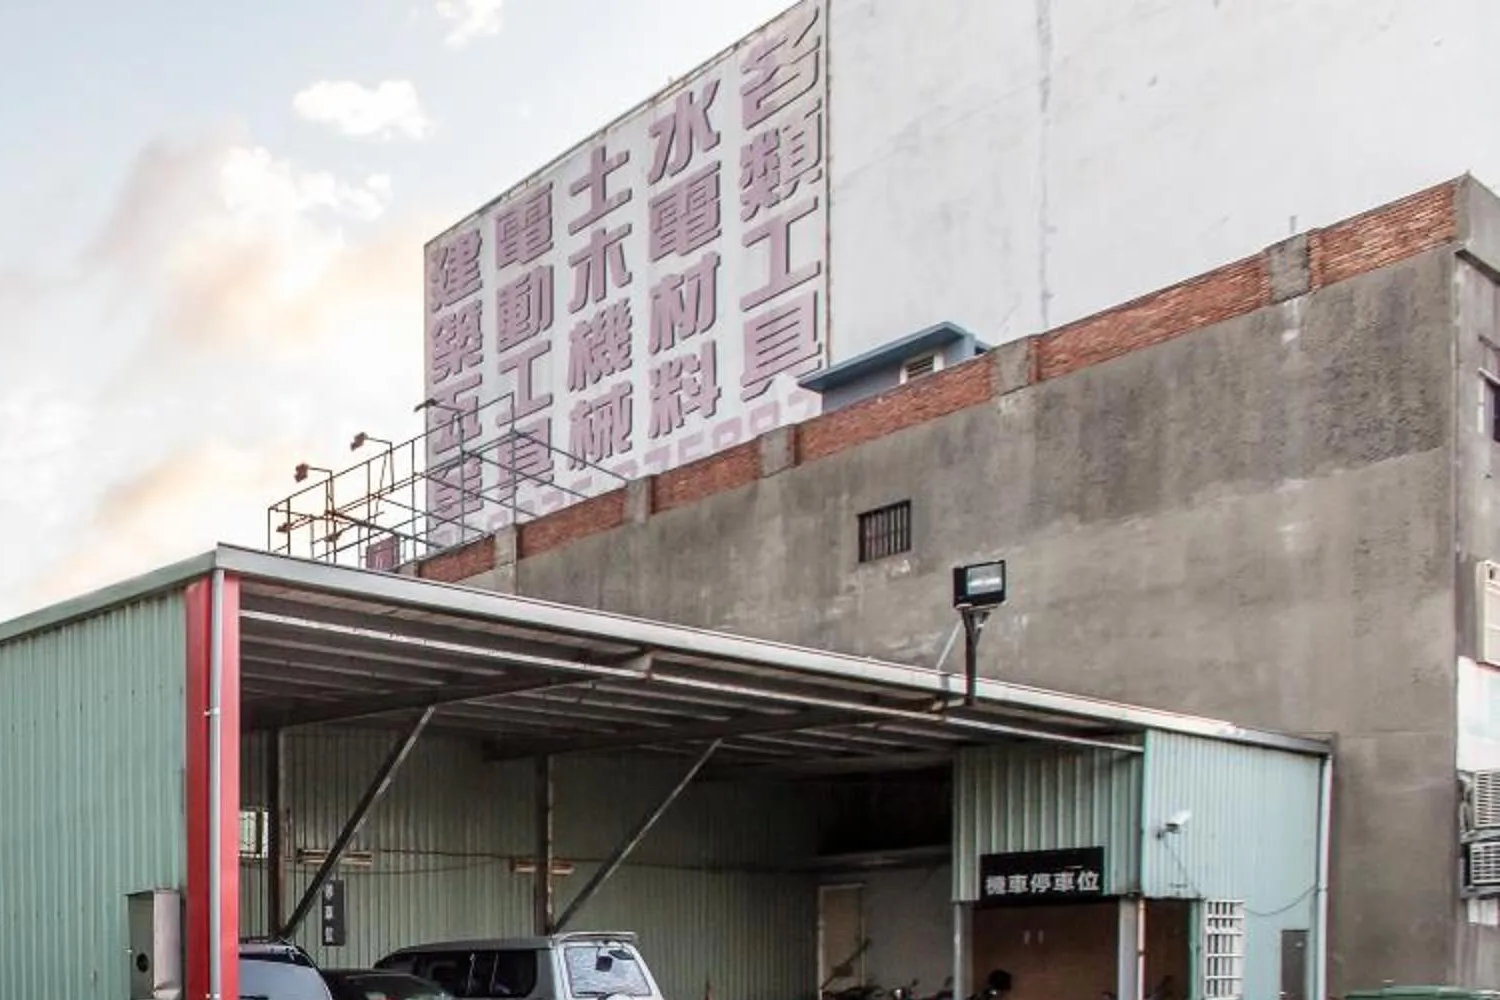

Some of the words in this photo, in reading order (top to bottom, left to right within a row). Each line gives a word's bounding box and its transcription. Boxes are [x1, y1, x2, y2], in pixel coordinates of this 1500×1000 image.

[494, 181, 554, 504] 電動工具
[568, 144, 632, 471] 土木機械
[648, 79, 721, 439] 水電材料
[740, 5, 821, 402] 各類工具
[430, 228, 484, 525] 建築五金
[986, 871, 1100, 895] 機車停車位
